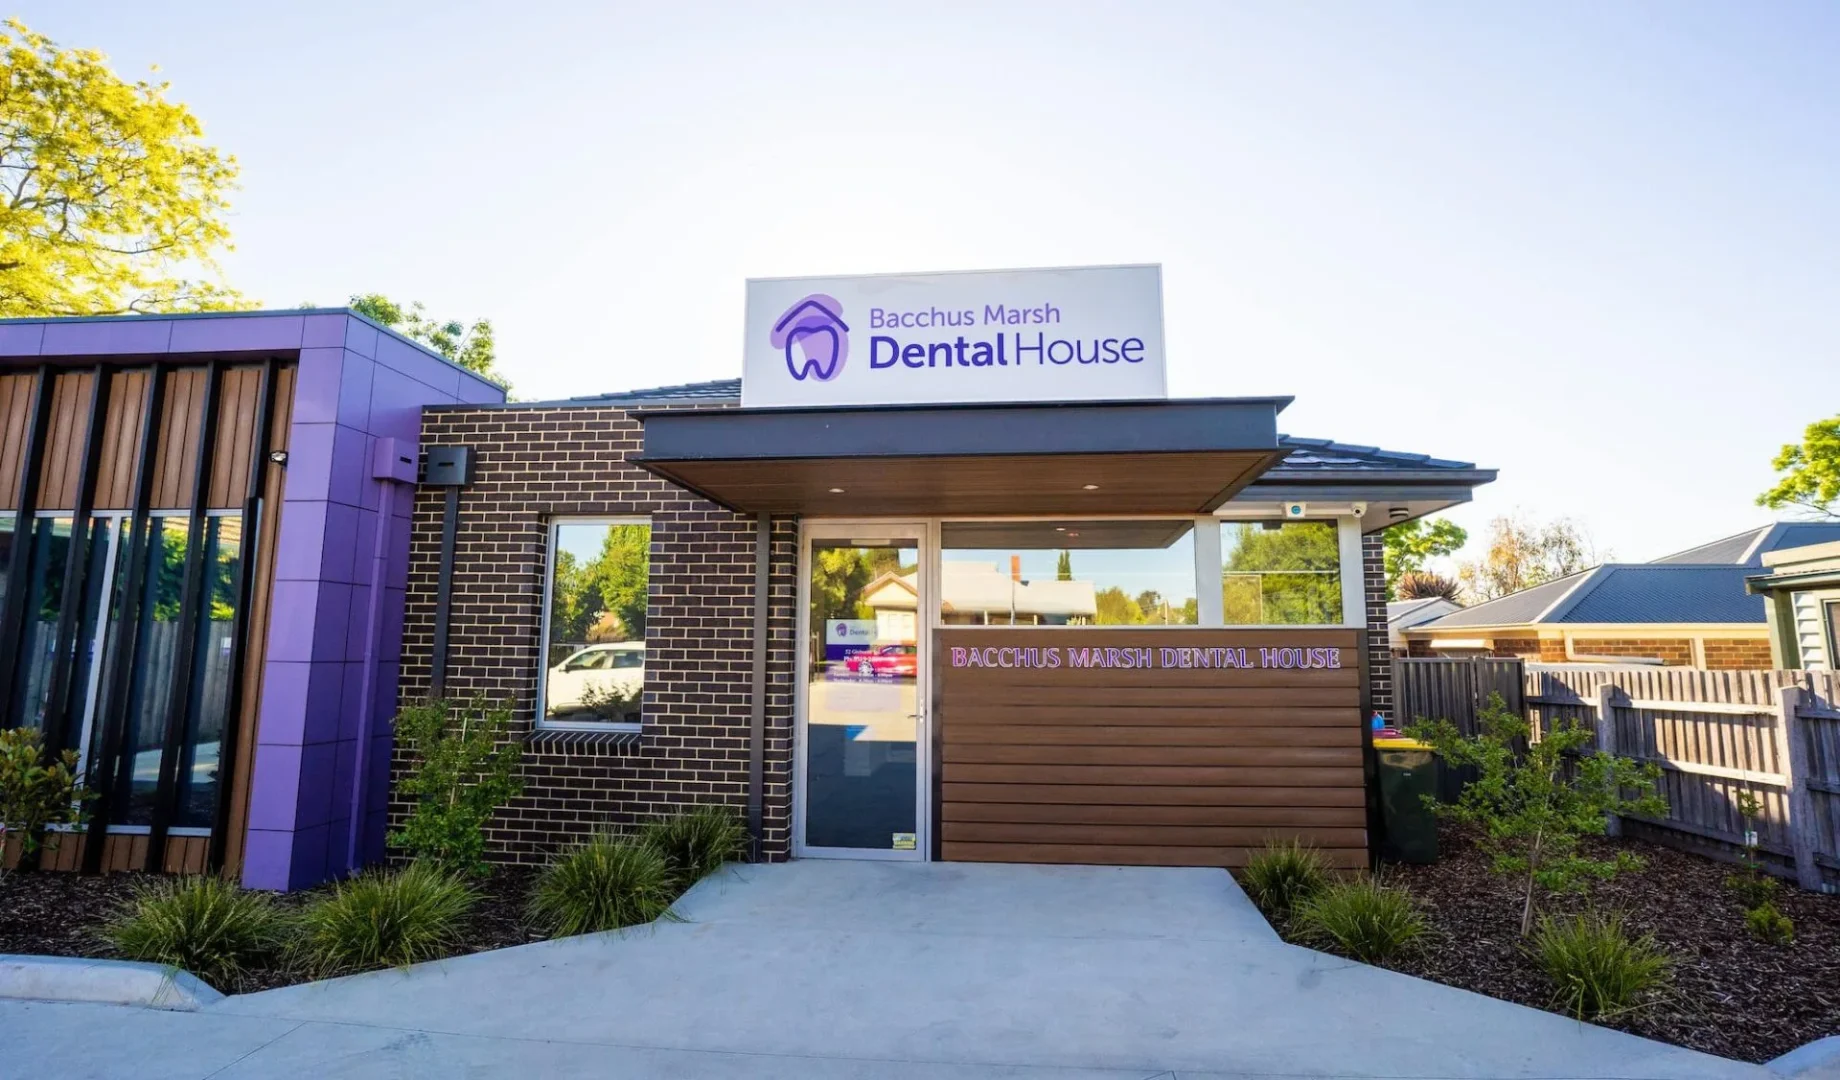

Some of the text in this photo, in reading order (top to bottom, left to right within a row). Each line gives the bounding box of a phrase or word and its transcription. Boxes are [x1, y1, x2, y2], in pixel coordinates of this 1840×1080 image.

[870, 303, 1061, 329] Bacchus Marsh
[951, 646, 1341, 669] BACCHUS MARSH DENTAL HOUSE
